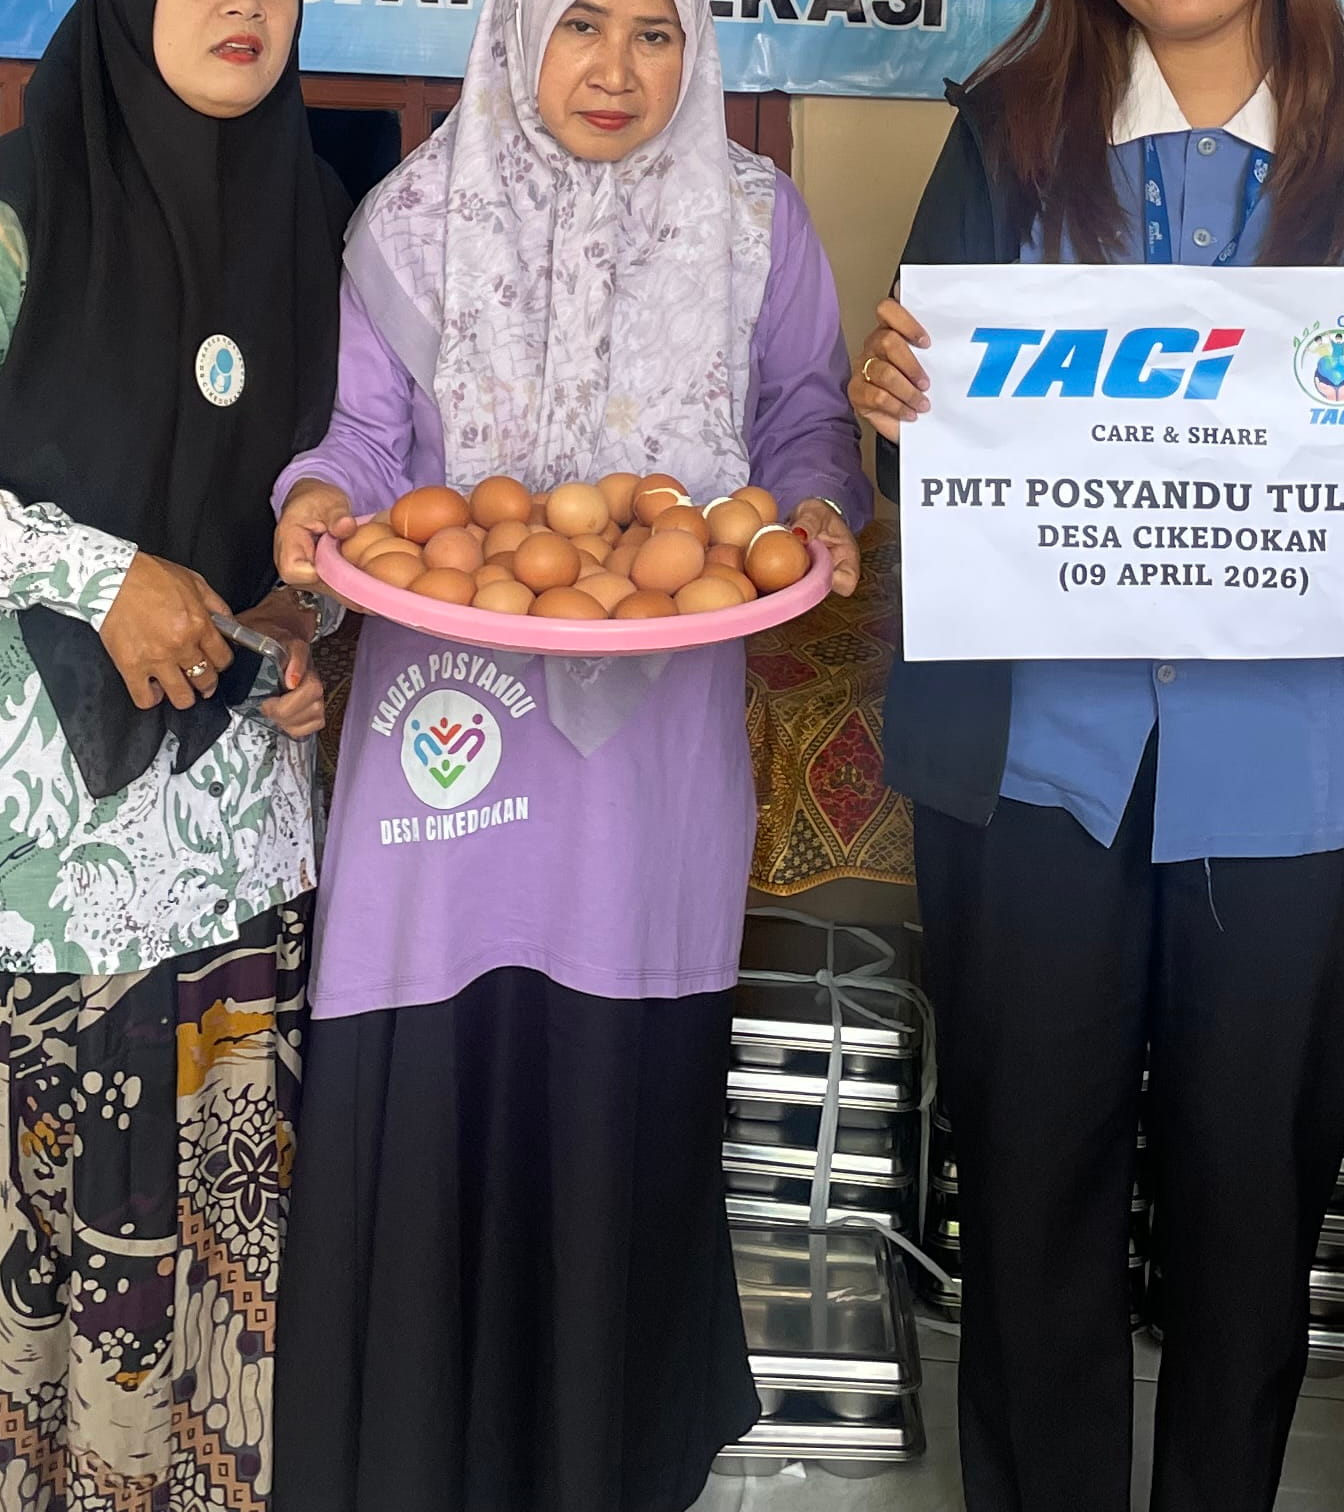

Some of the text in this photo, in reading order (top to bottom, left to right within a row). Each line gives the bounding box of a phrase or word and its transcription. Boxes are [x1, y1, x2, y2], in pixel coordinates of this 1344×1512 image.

[1091, 423, 1268, 447] CARE & SHARE
[920, 477, 1012, 508] PMT
[1024, 479, 1253, 513] POSYANDU
[1037, 524, 1329, 553] DESA CIKEDOKAN
[1058, 562, 1311, 597] (09 APRIL 2026)
[370, 650, 537, 737] KADER POSYANDU
[424, 796, 530, 841] CIKEDOKAN
